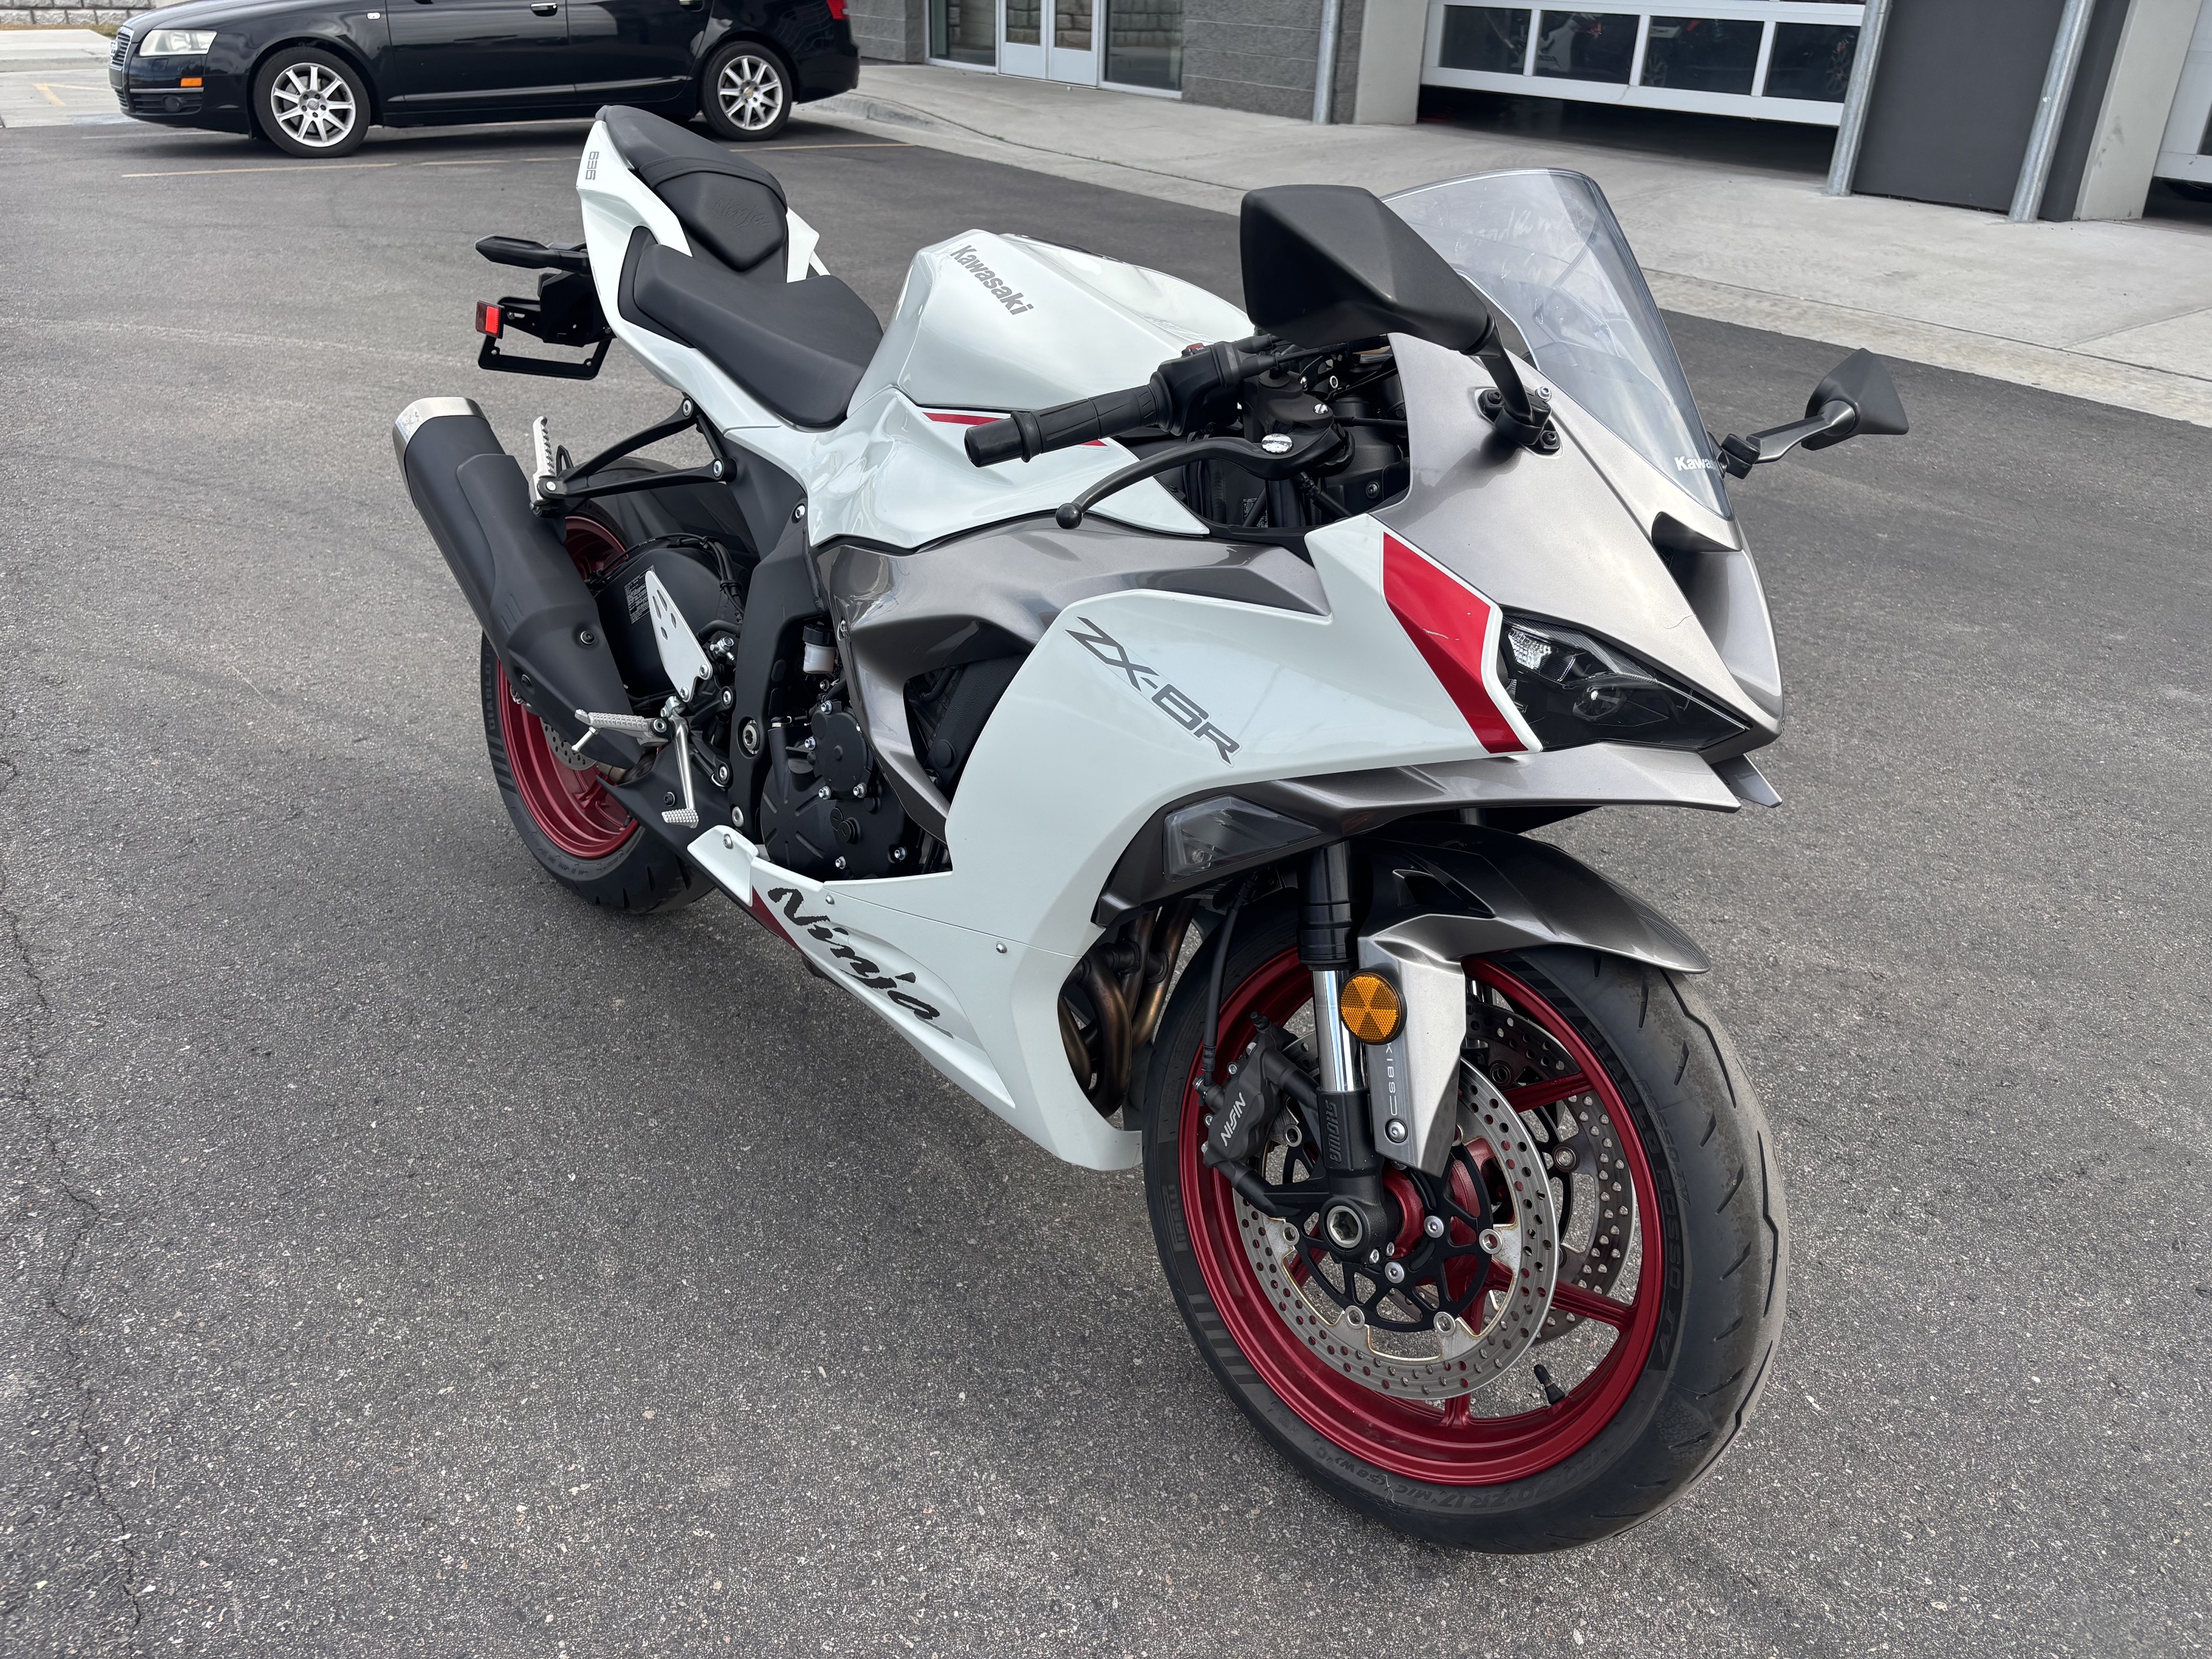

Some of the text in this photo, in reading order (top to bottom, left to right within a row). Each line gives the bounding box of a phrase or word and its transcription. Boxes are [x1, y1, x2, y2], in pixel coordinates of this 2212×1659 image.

[585, 150, 599, 180] 636
[950, 245, 1034, 315] Kawasaki
[485, 664, 496, 730] DIABLO
[1064, 616, 1240, 765] ZX-6R
[768, 887, 954, 1039] Ninja
[1385, 1042, 1396, 1094] KIBS
[1220, 1092, 1247, 1147] NISSIN
[1325, 1100, 1342, 1163] SHOWA
[1636, 1080, 1679, 1162] ROSSO
[1582, 1022, 1661, 1153] DIABLO
[1657, 1170, 1681, 1290] ROSSO
[1163, 1185, 1188, 1252] PIRELLI
